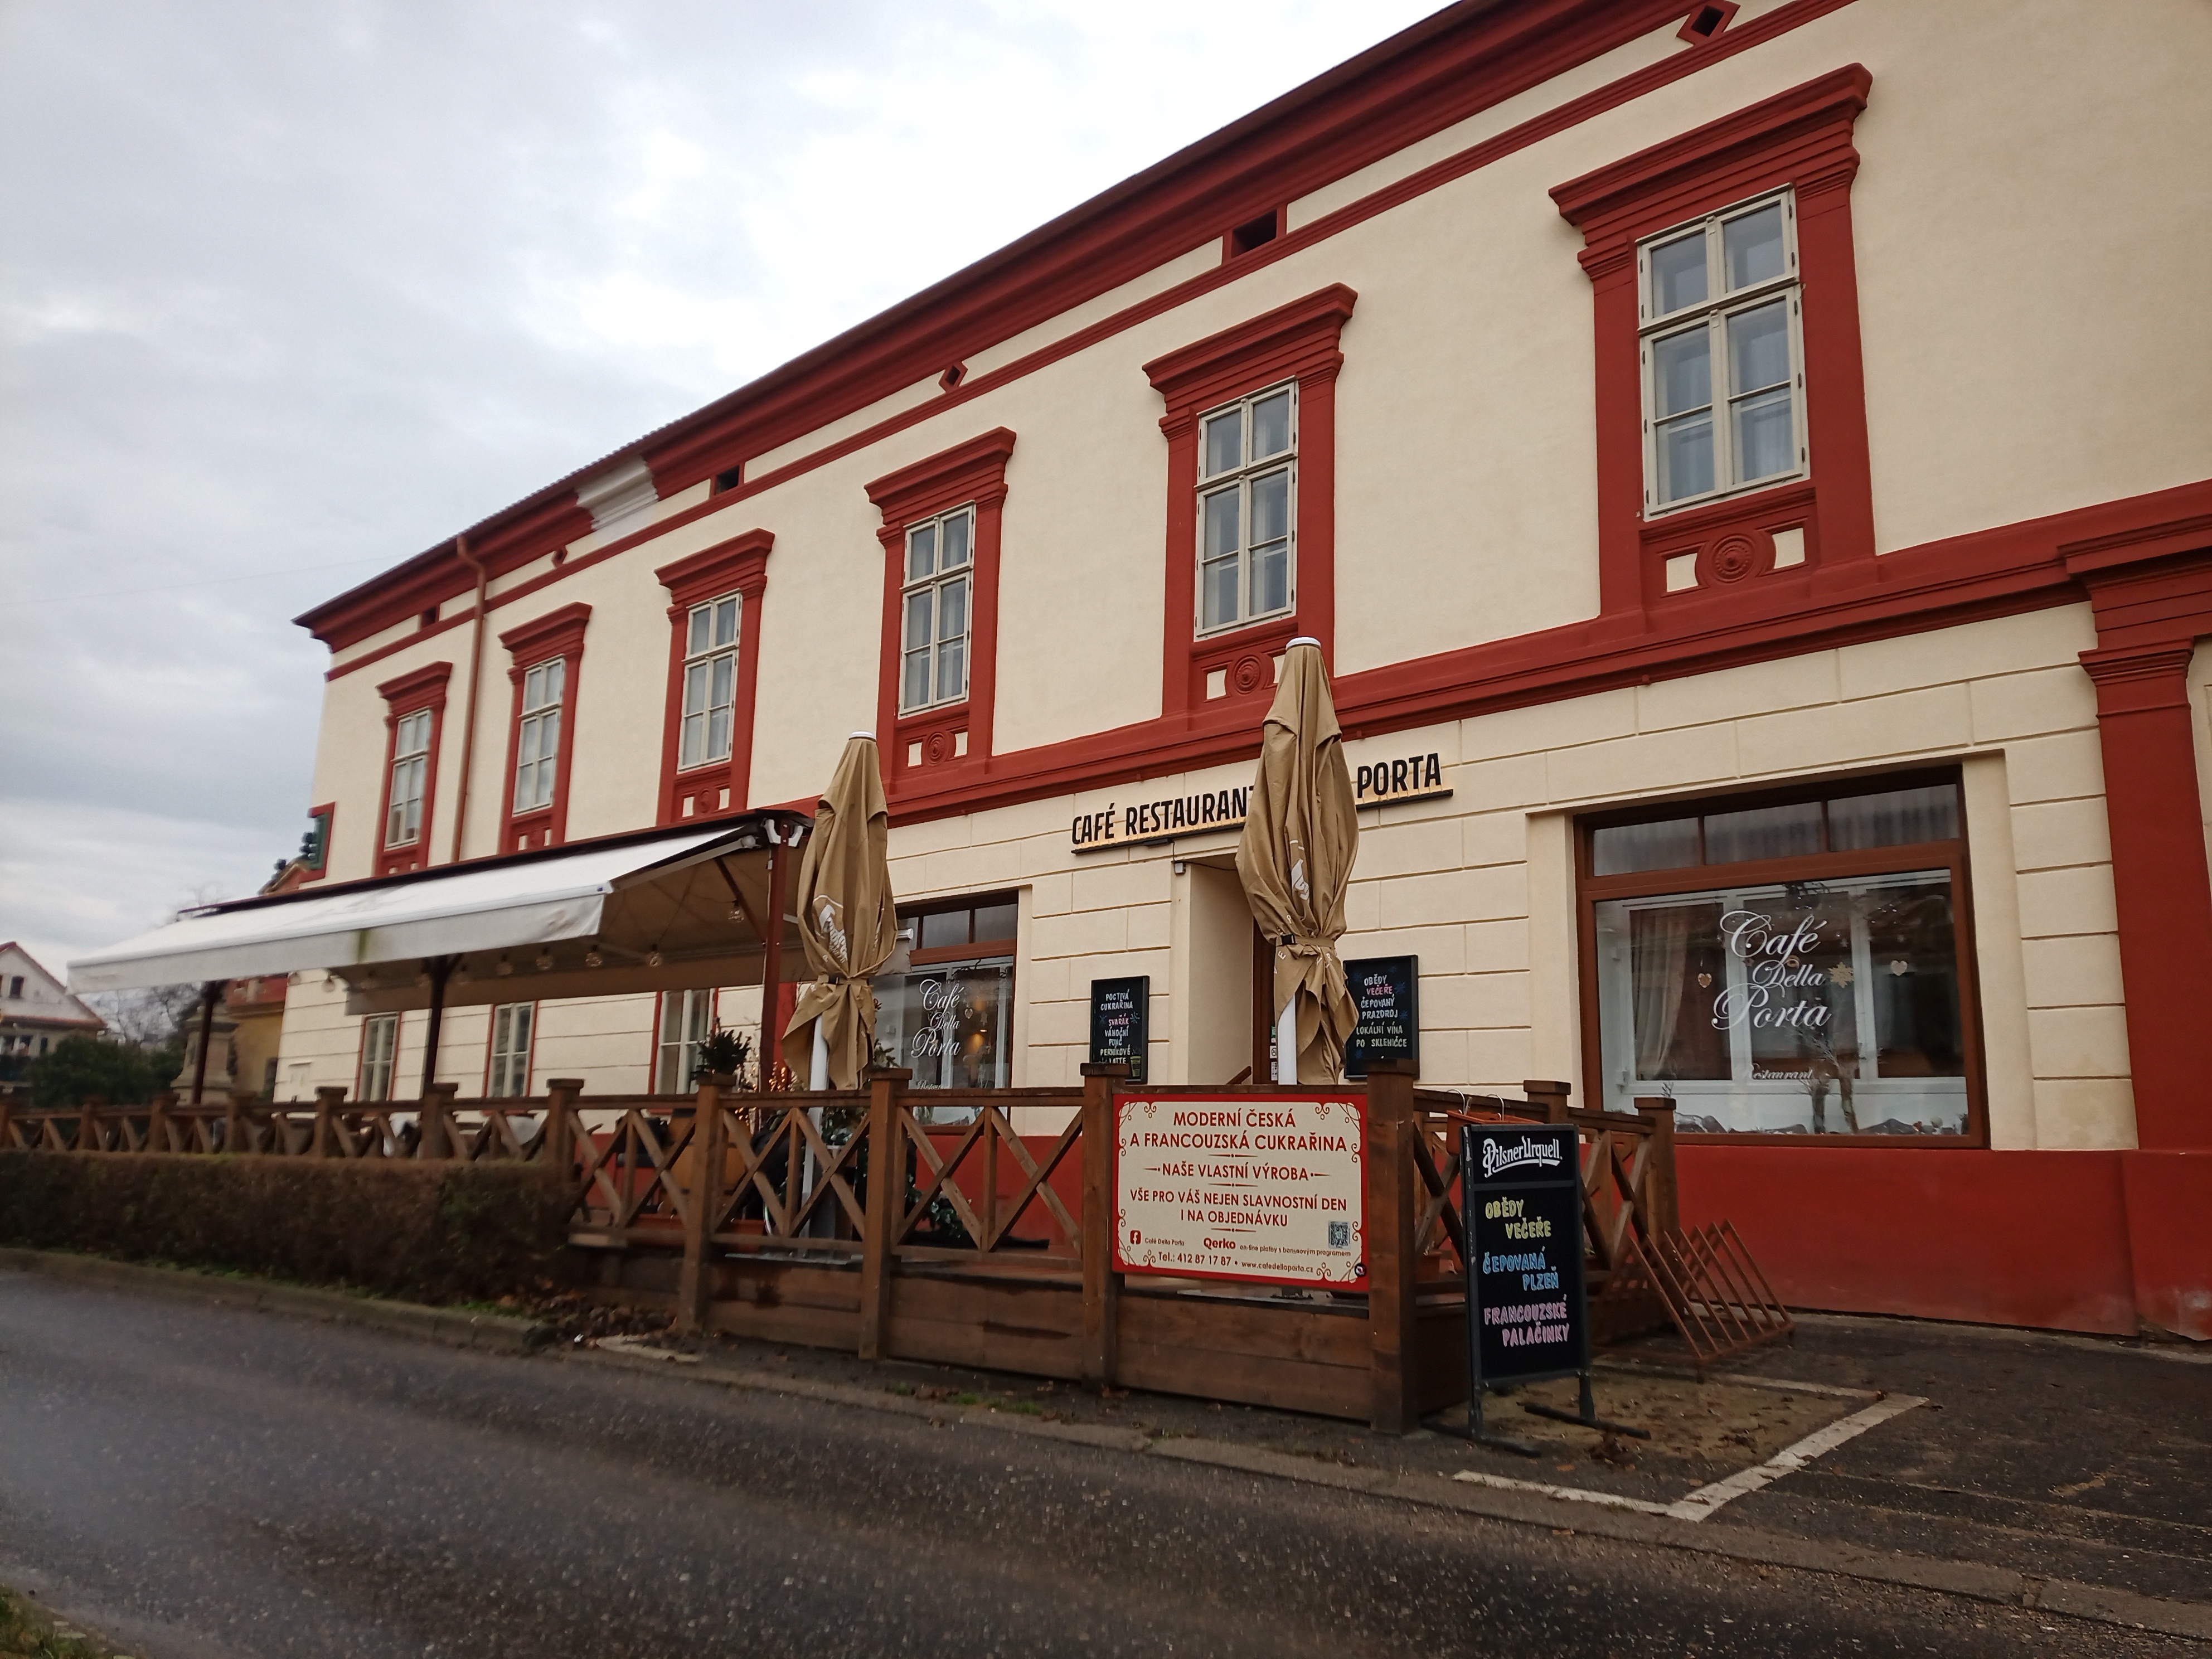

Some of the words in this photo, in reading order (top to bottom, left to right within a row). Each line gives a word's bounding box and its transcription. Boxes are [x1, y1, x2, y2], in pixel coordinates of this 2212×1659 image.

[1072, 802, 1115, 845] CAFÉ
[1126, 785, 1254, 836] RESTAURAN
[1357, 753, 1441, 798] PORTA
[1719, 910, 1827, 969] Café
[1364, 973, 1387, 986] OBĚDY
[1752, 959, 1825, 998] Della
[920, 979, 964, 1015] Café
[1105, 989, 1129, 1001] POCTIVÁ
[1361, 994, 1395, 1008] ČEPOVANÝ
[1366, 984, 1393, 996] VEČEŘE
[1100, 1000, 1133, 1011] CUKRAŘINA
[1362, 1010, 1398, 1020] PRAZDROJ
[1711, 982, 1831, 1030] Porta
[930, 1012, 960, 1037] Della
[1108, 1013, 1129, 1026] SVAŘÁK
[1356, 1021, 1385, 1035] LOKÁLNÍ
[1387, 1021, 1403, 1035] VÍNA
[911, 1027, 961, 1058] Porta
[1100, 1045, 1131, 1056] PERNÍKOVÉ
[1356, 1039, 1365, 1047] PO
[1371, 1036, 1407, 1047] SKLENIČCE
[1173, 1108, 1241, 1127] MODERNÍ
[1246, 1109, 1296, 1127] ČESKÁ
[1130, 1133, 1139, 1147] A
[1144, 1130, 1249, 1149] FRANCOUZSKÁ
[1254, 1132, 1347, 1152] CUKRAŘINA
[1482, 1138, 1523, 1178] Pilsner
[1163, 1161, 1194, 1176] NAŠE
[1198, 1162, 1249, 1178] VLASTNÍ
[1253, 1163, 1309, 1181] VÝROBA
[1130, 1187, 1149, 1201] VŠE
[1152, 1191, 1174, 1203] PRO
[1178, 1188, 1200, 1204] VÁŠ
[1204, 1193, 1239, 1206] NEJEN
[1243, 1193, 1318, 1210] SLAVNOSTNÍ
[1322, 1197, 1347, 1211] DEN
[1485, 1196, 1524, 1219] OBĚDY
[1181, 1210, 1184, 1221] I
[1188, 1210, 1204, 1222] NA
[1208, 1209, 1288, 1226] OBJEDNÁVKU
[1505, 1216, 1551, 1239] VEČEŘE
[1204, 1237, 1236, 1250] Qerko
[1158, 1251, 1175, 1262] Tel.:
[1177, 1253, 1192, 1263] 412
[1195, 1255, 1205, 1264] 87
[1209, 1255, 1218, 1265] 17
[1220, 1256, 1231, 1266] 87
[1241, 1262, 1313, 1273] www.cafedellaporta.cz
[1483, 1246, 1546, 1274] ČEPOVANÁ
[1522, 1266, 1559, 1291] PLZEŇ
[1484, 1293, 1567, 1326] FRANCOUZSKÉ
[1502, 1321, 1570, 1347] PALAČINKY
